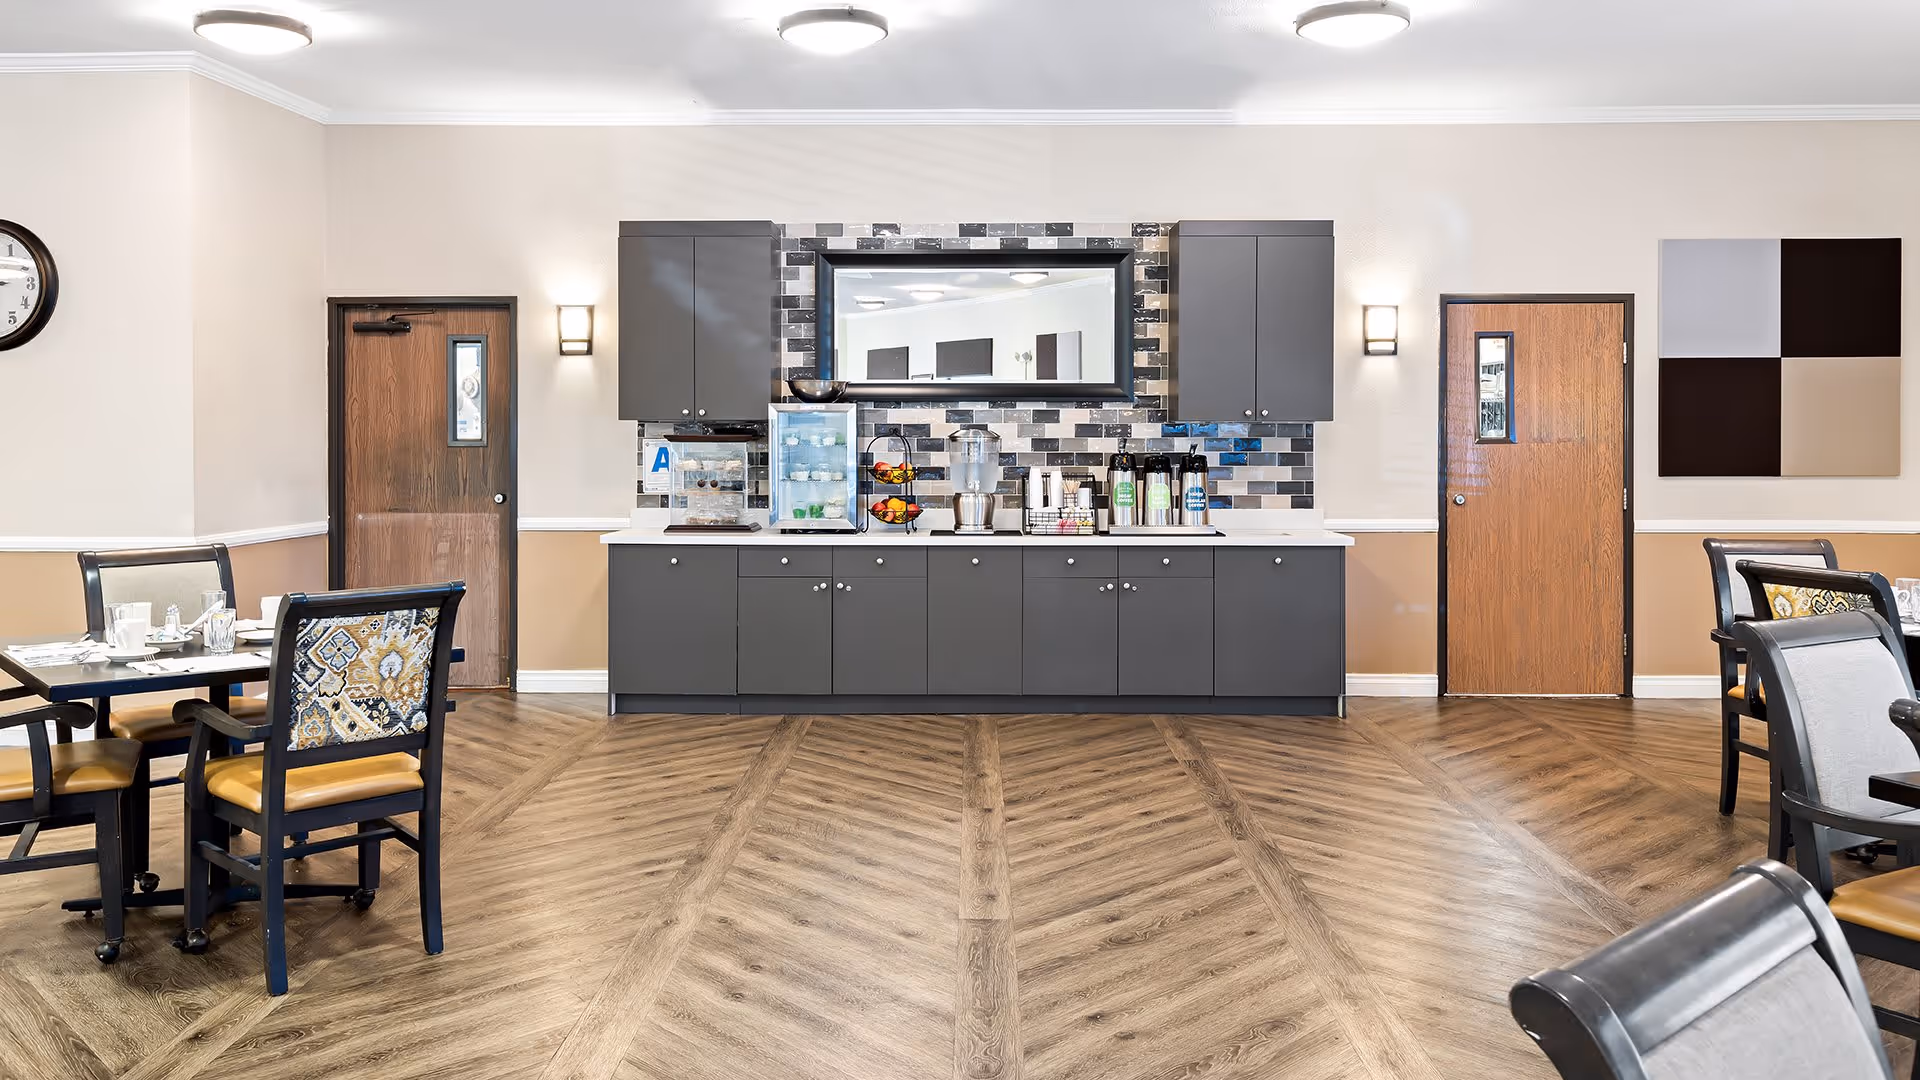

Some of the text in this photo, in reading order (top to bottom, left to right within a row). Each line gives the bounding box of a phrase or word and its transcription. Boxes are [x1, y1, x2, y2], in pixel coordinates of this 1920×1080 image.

[8, 244, 14, 257] 1
[26, 277, 36, 290] 3
[20, 296, 30, 310] 4
[8, 311, 17, 325] 5
[651, 446, 670, 473] A
